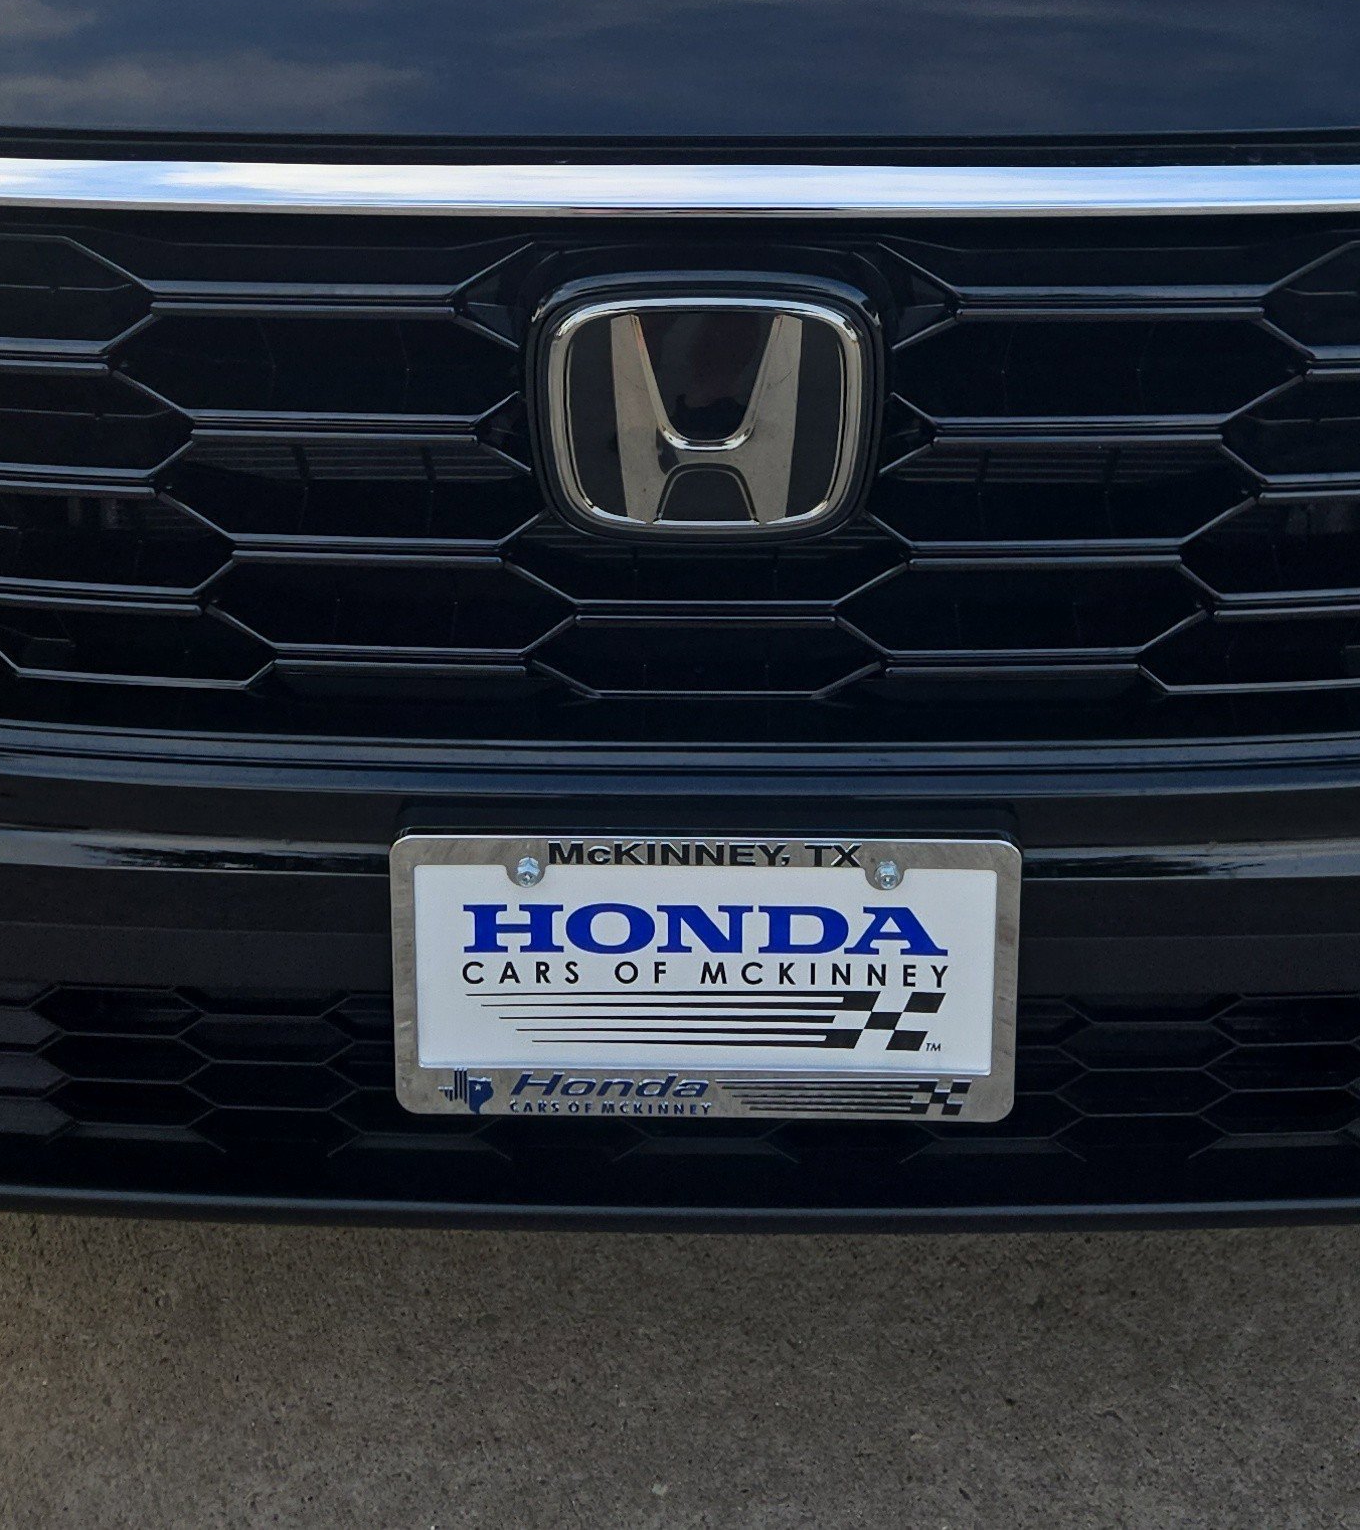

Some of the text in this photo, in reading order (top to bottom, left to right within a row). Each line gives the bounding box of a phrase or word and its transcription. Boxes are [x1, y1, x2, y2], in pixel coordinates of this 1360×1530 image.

[547, 840, 863, 868] McKINNEY, TX
[463, 903, 949, 957] HONDA
[462, 961, 949, 989] CARS OF MCKINNEY
[926, 1042, 942, 1052] TM
[509, 1071, 710, 1098] Honda
[509, 1099, 713, 1115] CARS OF MCKINNEY
